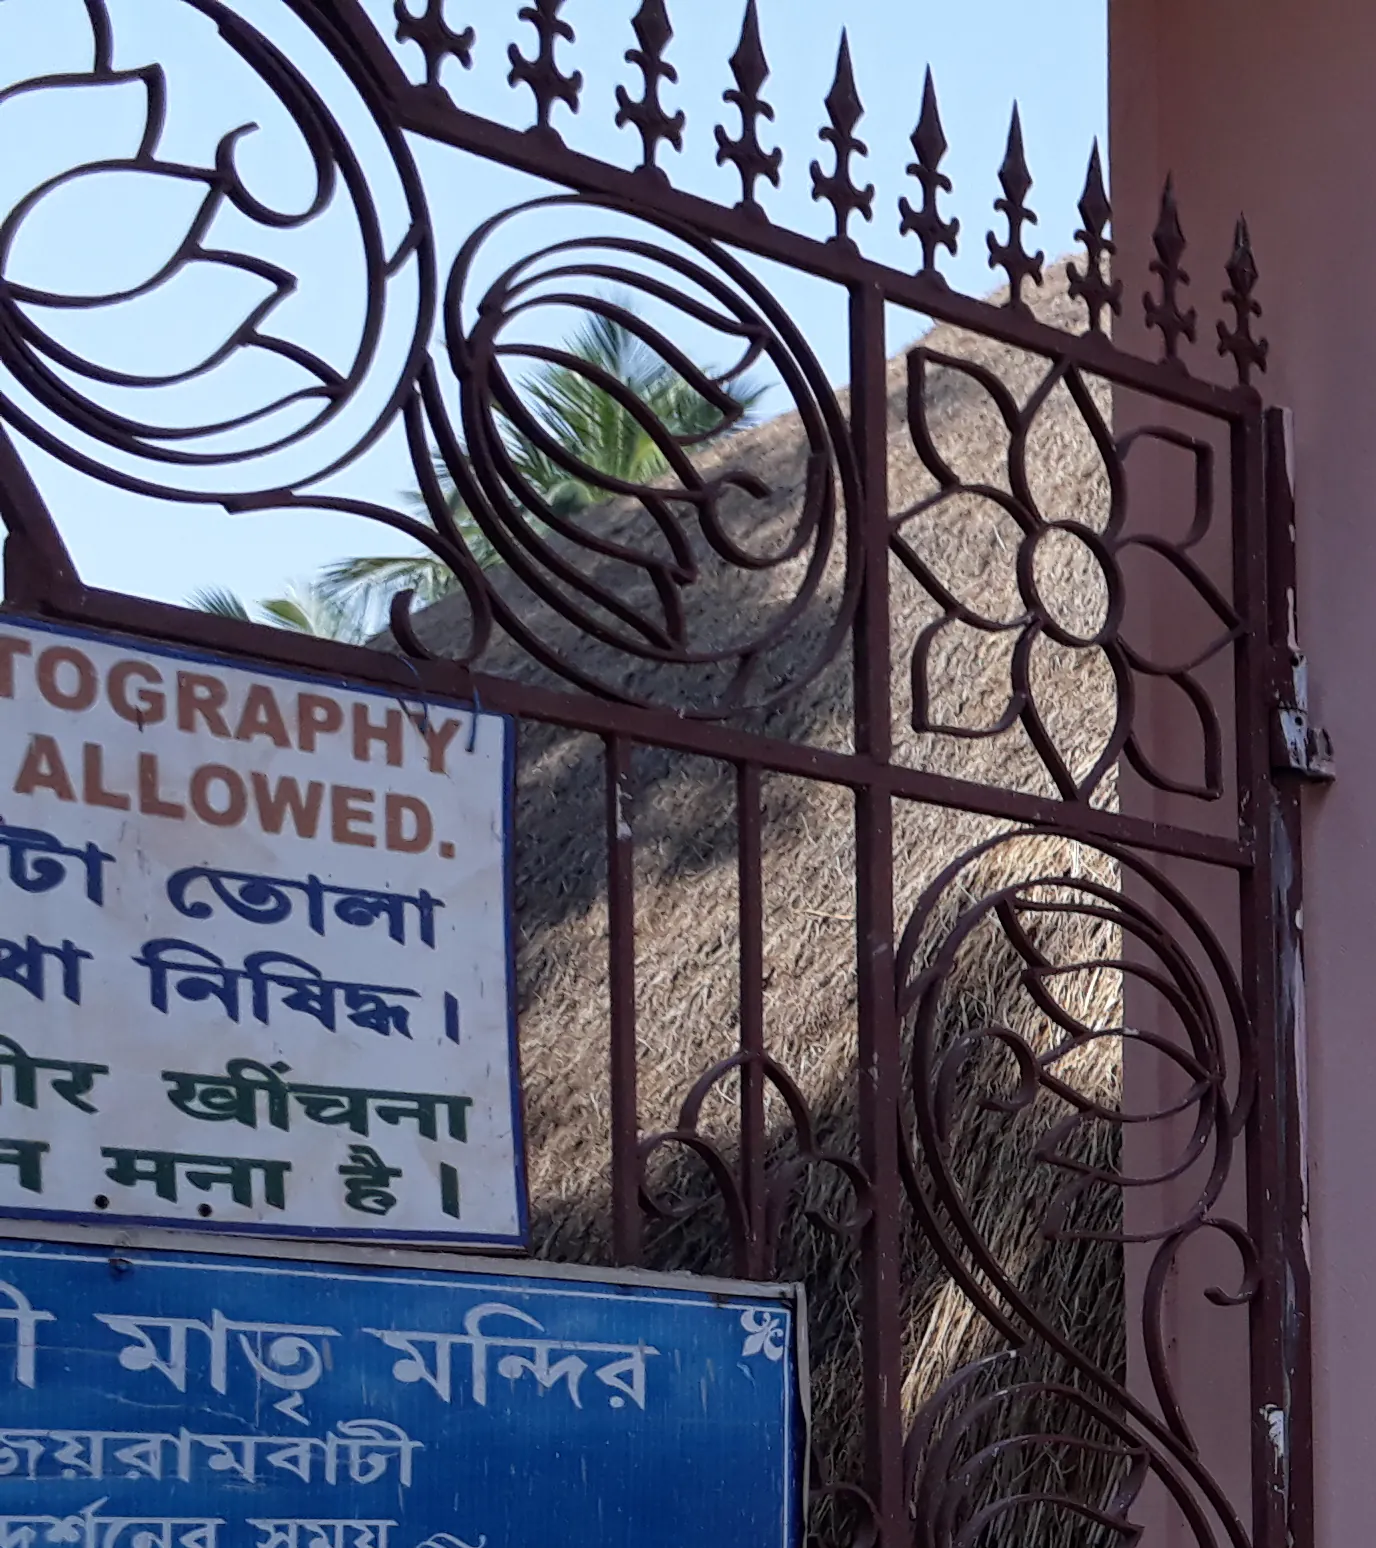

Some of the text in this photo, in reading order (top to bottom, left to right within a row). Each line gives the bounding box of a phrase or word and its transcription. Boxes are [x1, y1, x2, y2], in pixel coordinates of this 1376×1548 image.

[0, 634, 460, 774] TOGRAPHY
[13, 734, 456, 859] ALLOWED.
[167, 866, 446, 950] তোলা
[162, 1057, 473, 1144] खींचना
[101, 1146, 292, 1209] मना
[94, 1308, 341, 1426] মাতৃ
[363, 1301, 660, 1411] মন্দির
